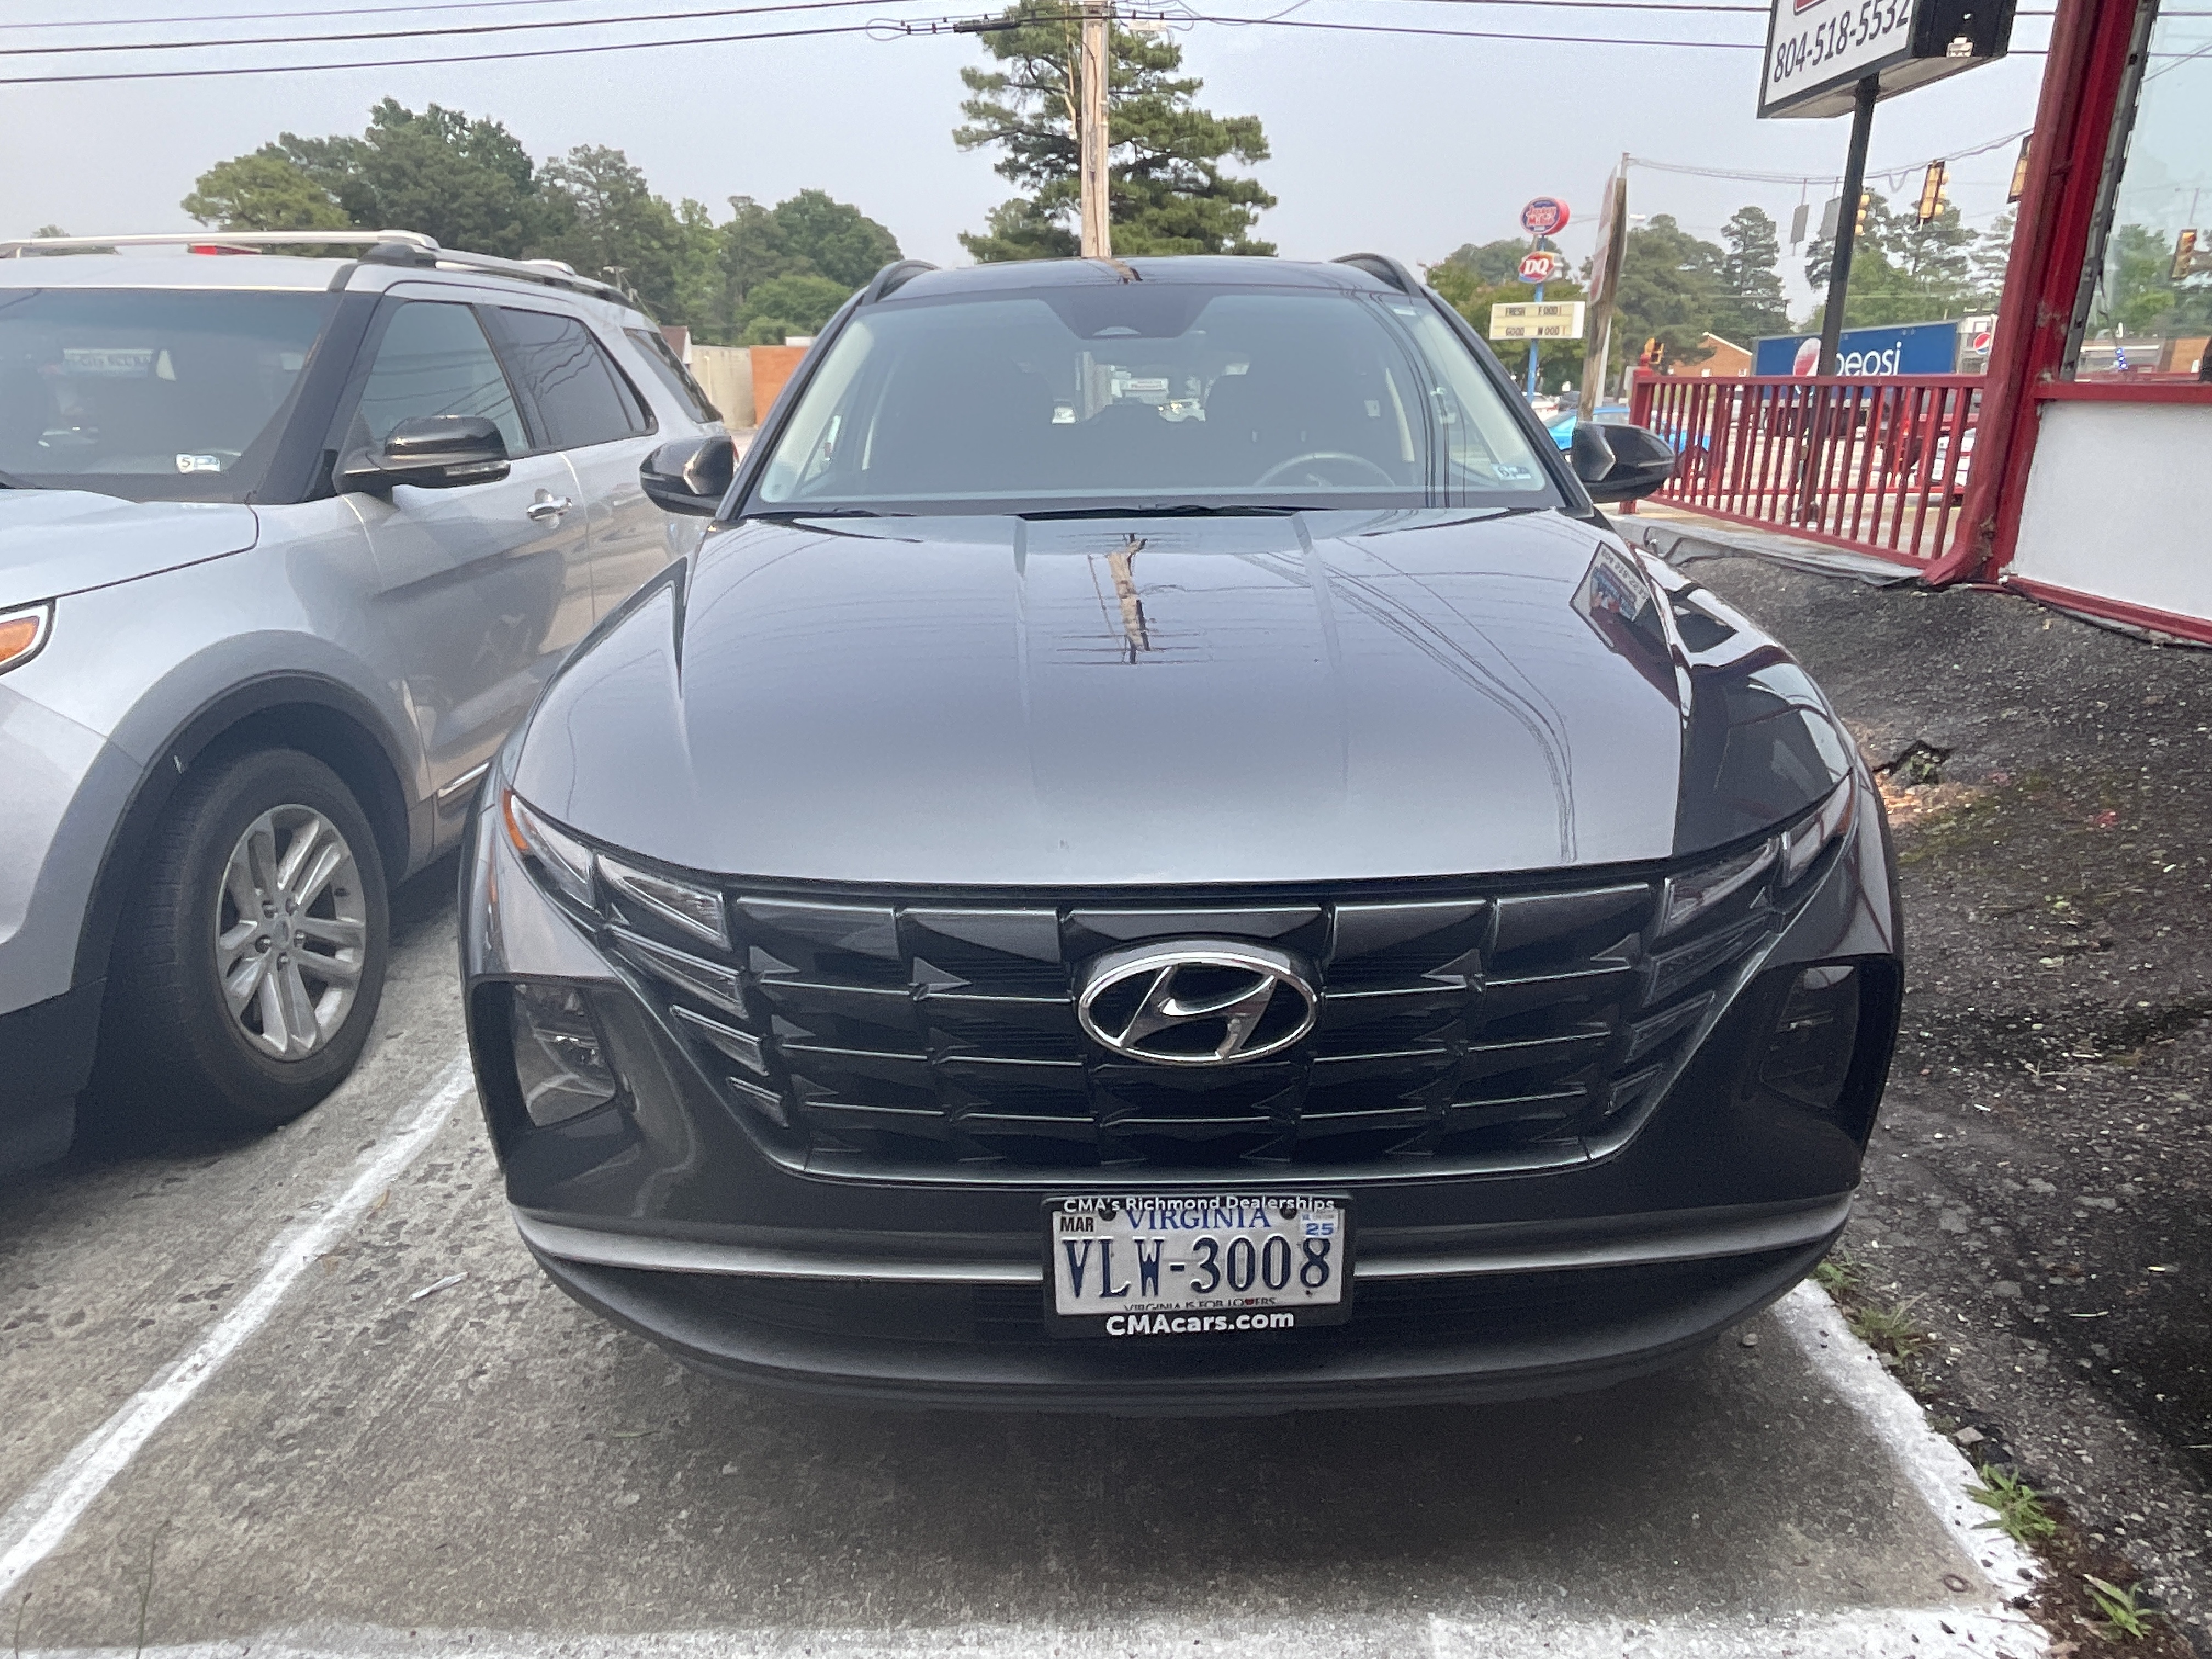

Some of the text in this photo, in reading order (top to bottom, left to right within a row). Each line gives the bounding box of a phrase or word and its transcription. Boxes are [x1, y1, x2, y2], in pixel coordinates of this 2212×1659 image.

[1774, 0, 1910, 82] 804-518-5532
[1523, 258, 1549, 275] DQ
[1063, 1195, 1335, 1213] CMA's Richmond Dealerships
[1060, 1208, 1335, 1236] MAR VIRGINIA 25
[1060, 1234, 1331, 1299] VLW-3008
[1105, 1312, 1295, 1336] CMAcars.com
